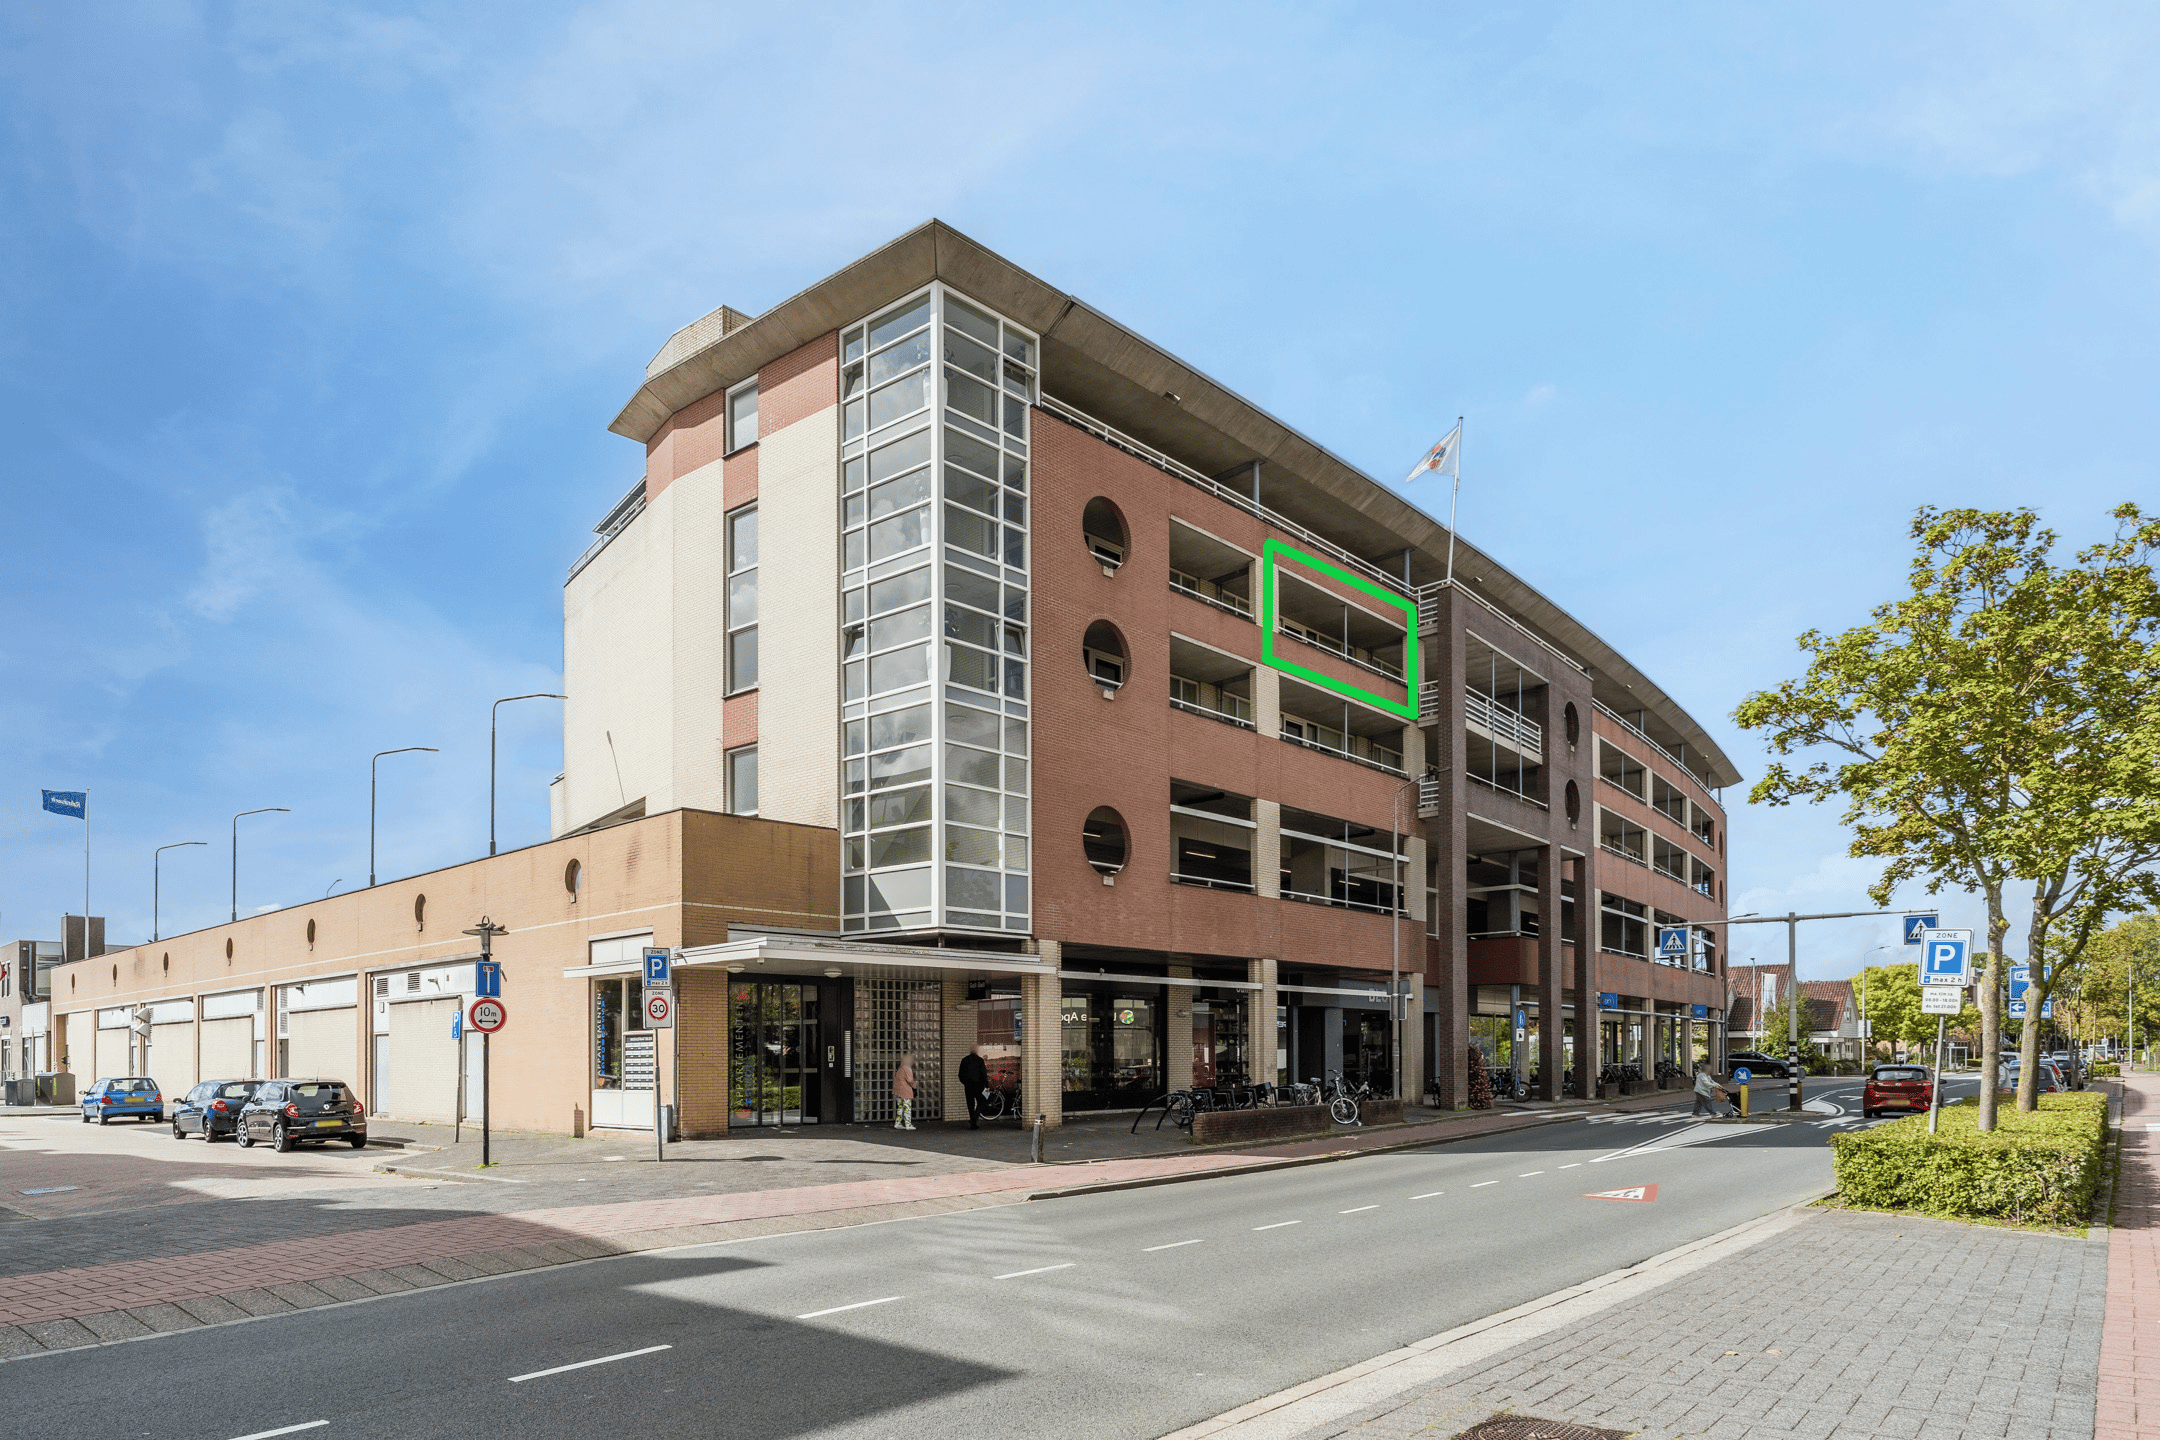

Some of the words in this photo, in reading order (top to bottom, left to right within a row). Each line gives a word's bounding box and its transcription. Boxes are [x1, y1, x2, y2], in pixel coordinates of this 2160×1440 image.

[1933, 944, 1956, 971] P
[651, 958, 663, 977] P
[479, 1006, 490, 1017] 10
[652, 1004, 665, 1013] 30
[735, 1002, 744, 1107] APPARTEMENTEN
